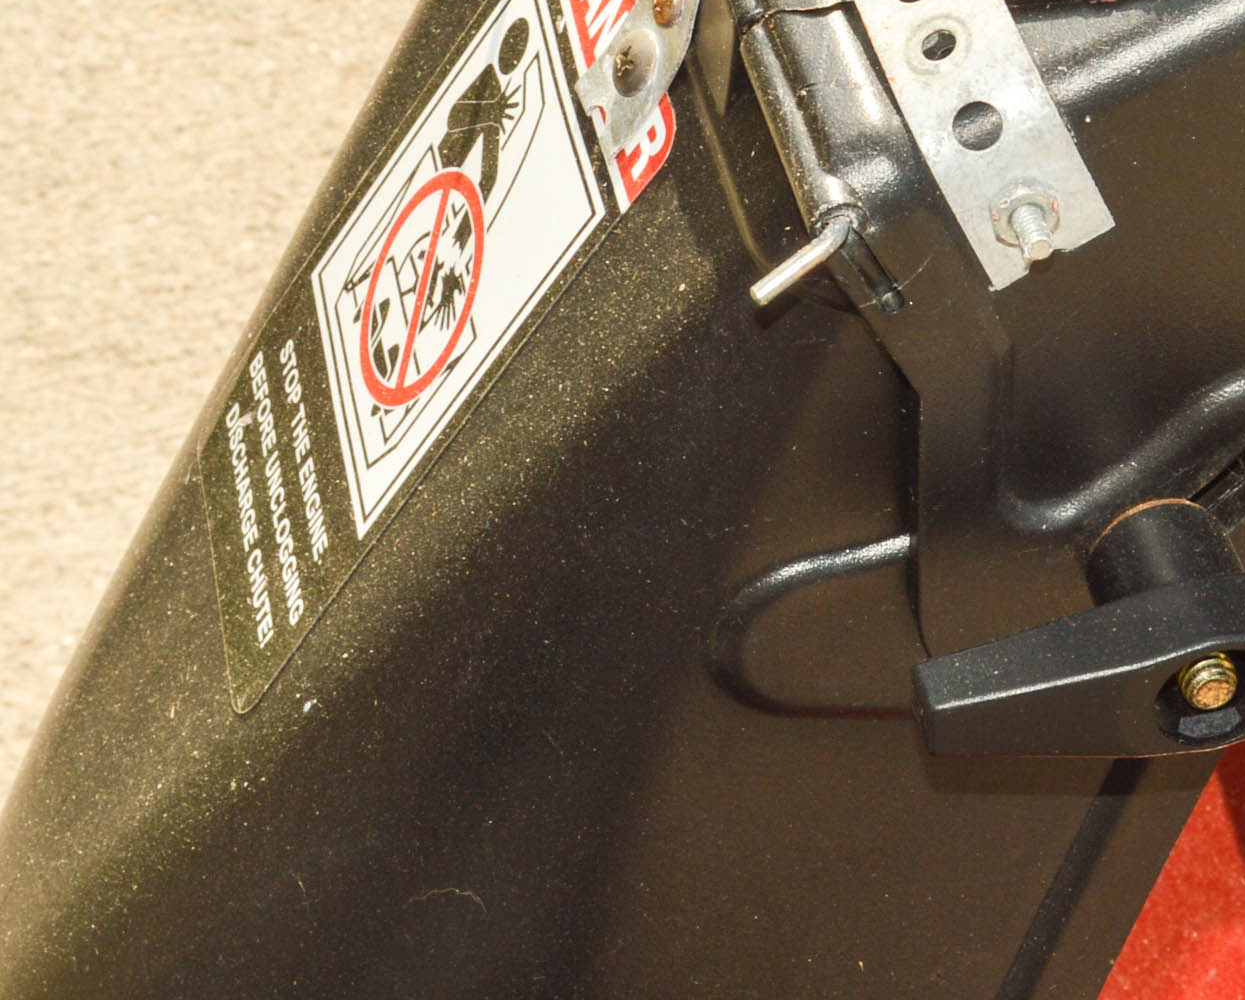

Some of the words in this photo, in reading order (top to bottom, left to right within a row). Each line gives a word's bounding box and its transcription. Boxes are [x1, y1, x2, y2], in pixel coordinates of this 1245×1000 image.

[280, 339, 302, 405] STOP
[225, 402, 259, 552] DISCHARGE
[289, 403, 311, 464] THE
[249, 351, 277, 457] BEFORE
[265, 455, 304, 626] UNCLOGGING
[298, 462, 329, 562] ENGINE
